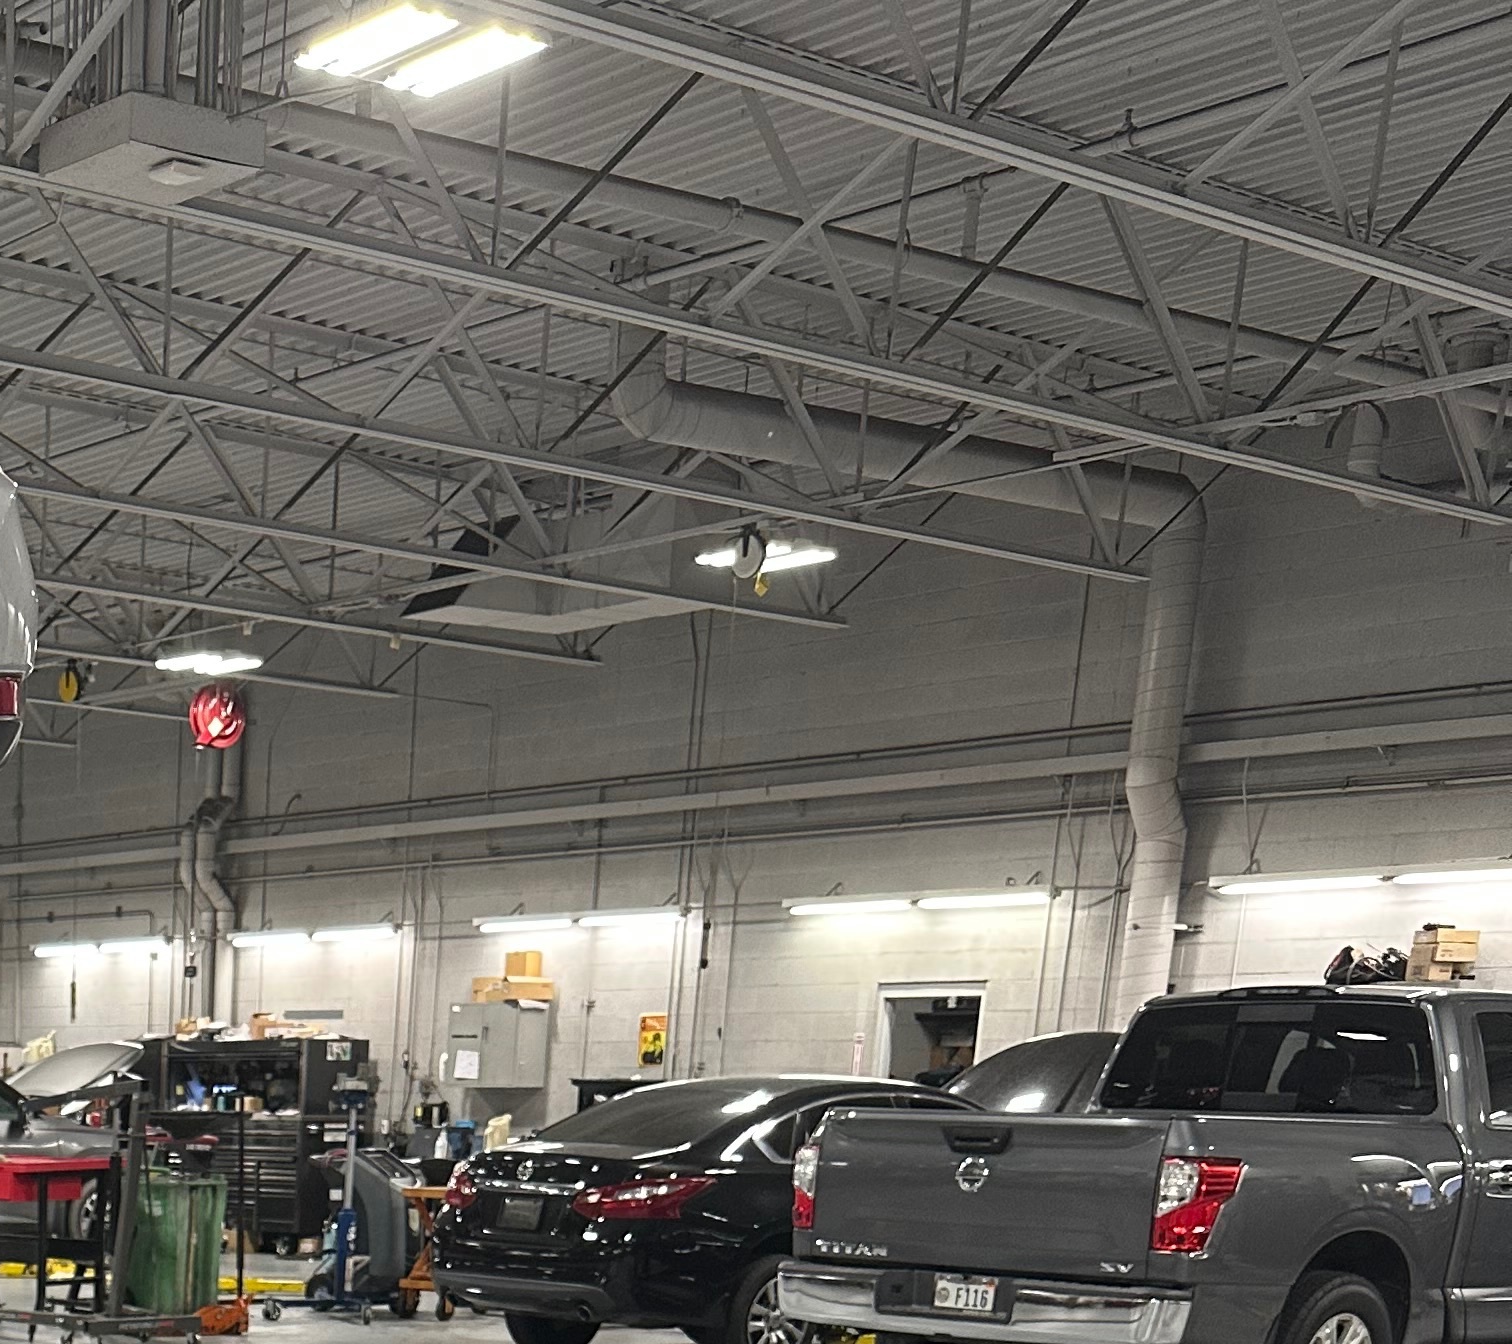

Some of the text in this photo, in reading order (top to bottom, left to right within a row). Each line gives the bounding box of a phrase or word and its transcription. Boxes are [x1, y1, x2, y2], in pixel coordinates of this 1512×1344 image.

[816, 1238, 889, 1258] TITAN
[1099, 1261, 1135, 1274] SV
[954, 1288, 988, 1308] F116
